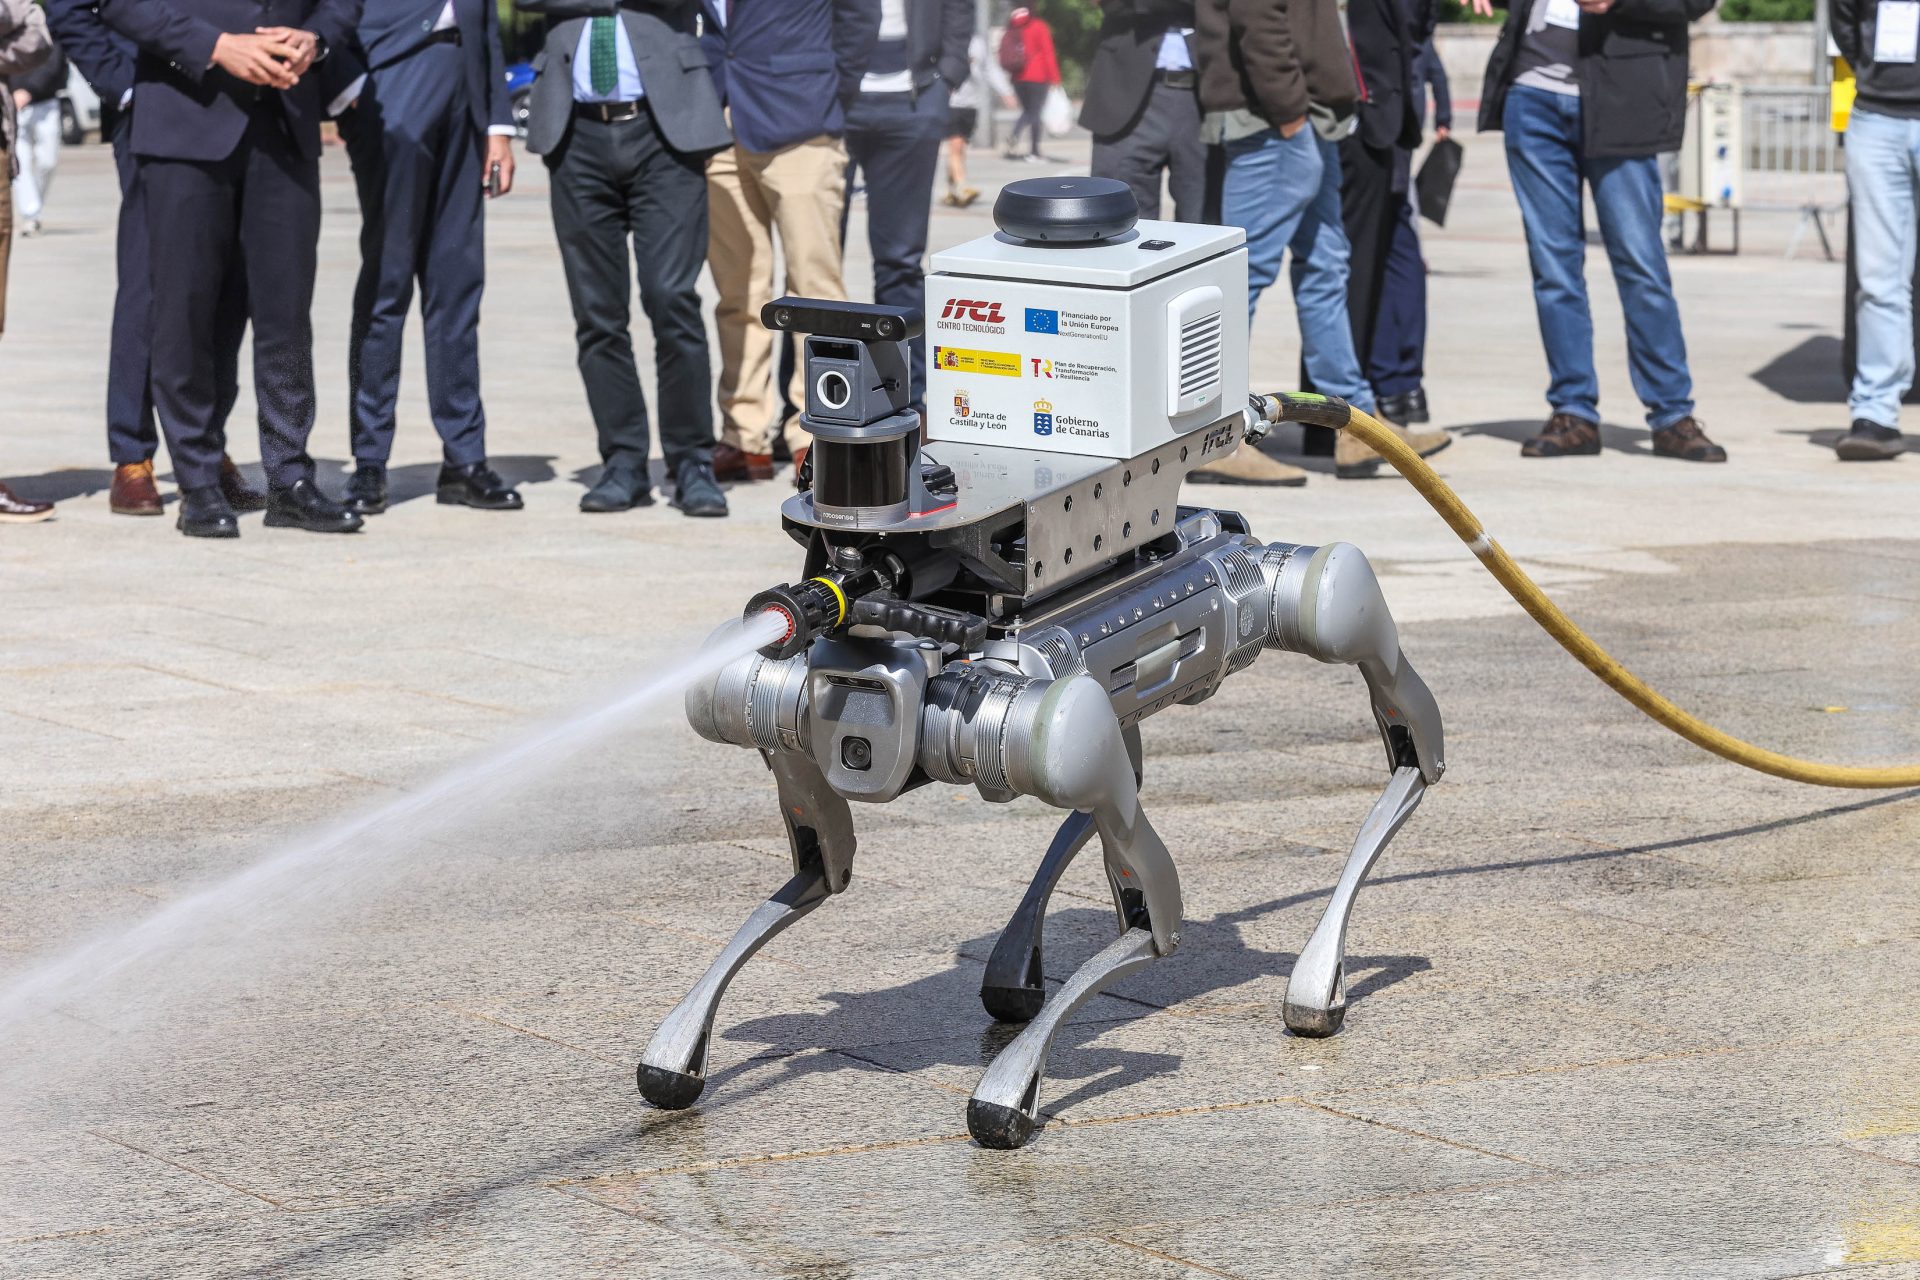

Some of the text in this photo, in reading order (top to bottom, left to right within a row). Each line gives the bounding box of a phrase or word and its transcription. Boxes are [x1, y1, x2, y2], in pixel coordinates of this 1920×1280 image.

[941, 298, 1006, 324] ITCL
[1061, 310, 1112, 323] Financiado por
[937, 320, 1005, 335] CENTRO TECNOLÓGICO
[1069, 321, 1089, 329] Unión
[1090, 322, 1119, 332] Europea
[1055, 367, 1099, 377] Transformación
[1076, 363, 1117, 373] Recuperación,
[1060, 374, 1090, 382] Resiliencia
[971, 410, 1007, 421] Junta de
[1055, 415, 1099, 428] Gobierno
[949, 417, 1007, 431] Castilla y León
[1055, 424, 1110, 439] de Canarias
[823, 512, 854, 521] robosense
